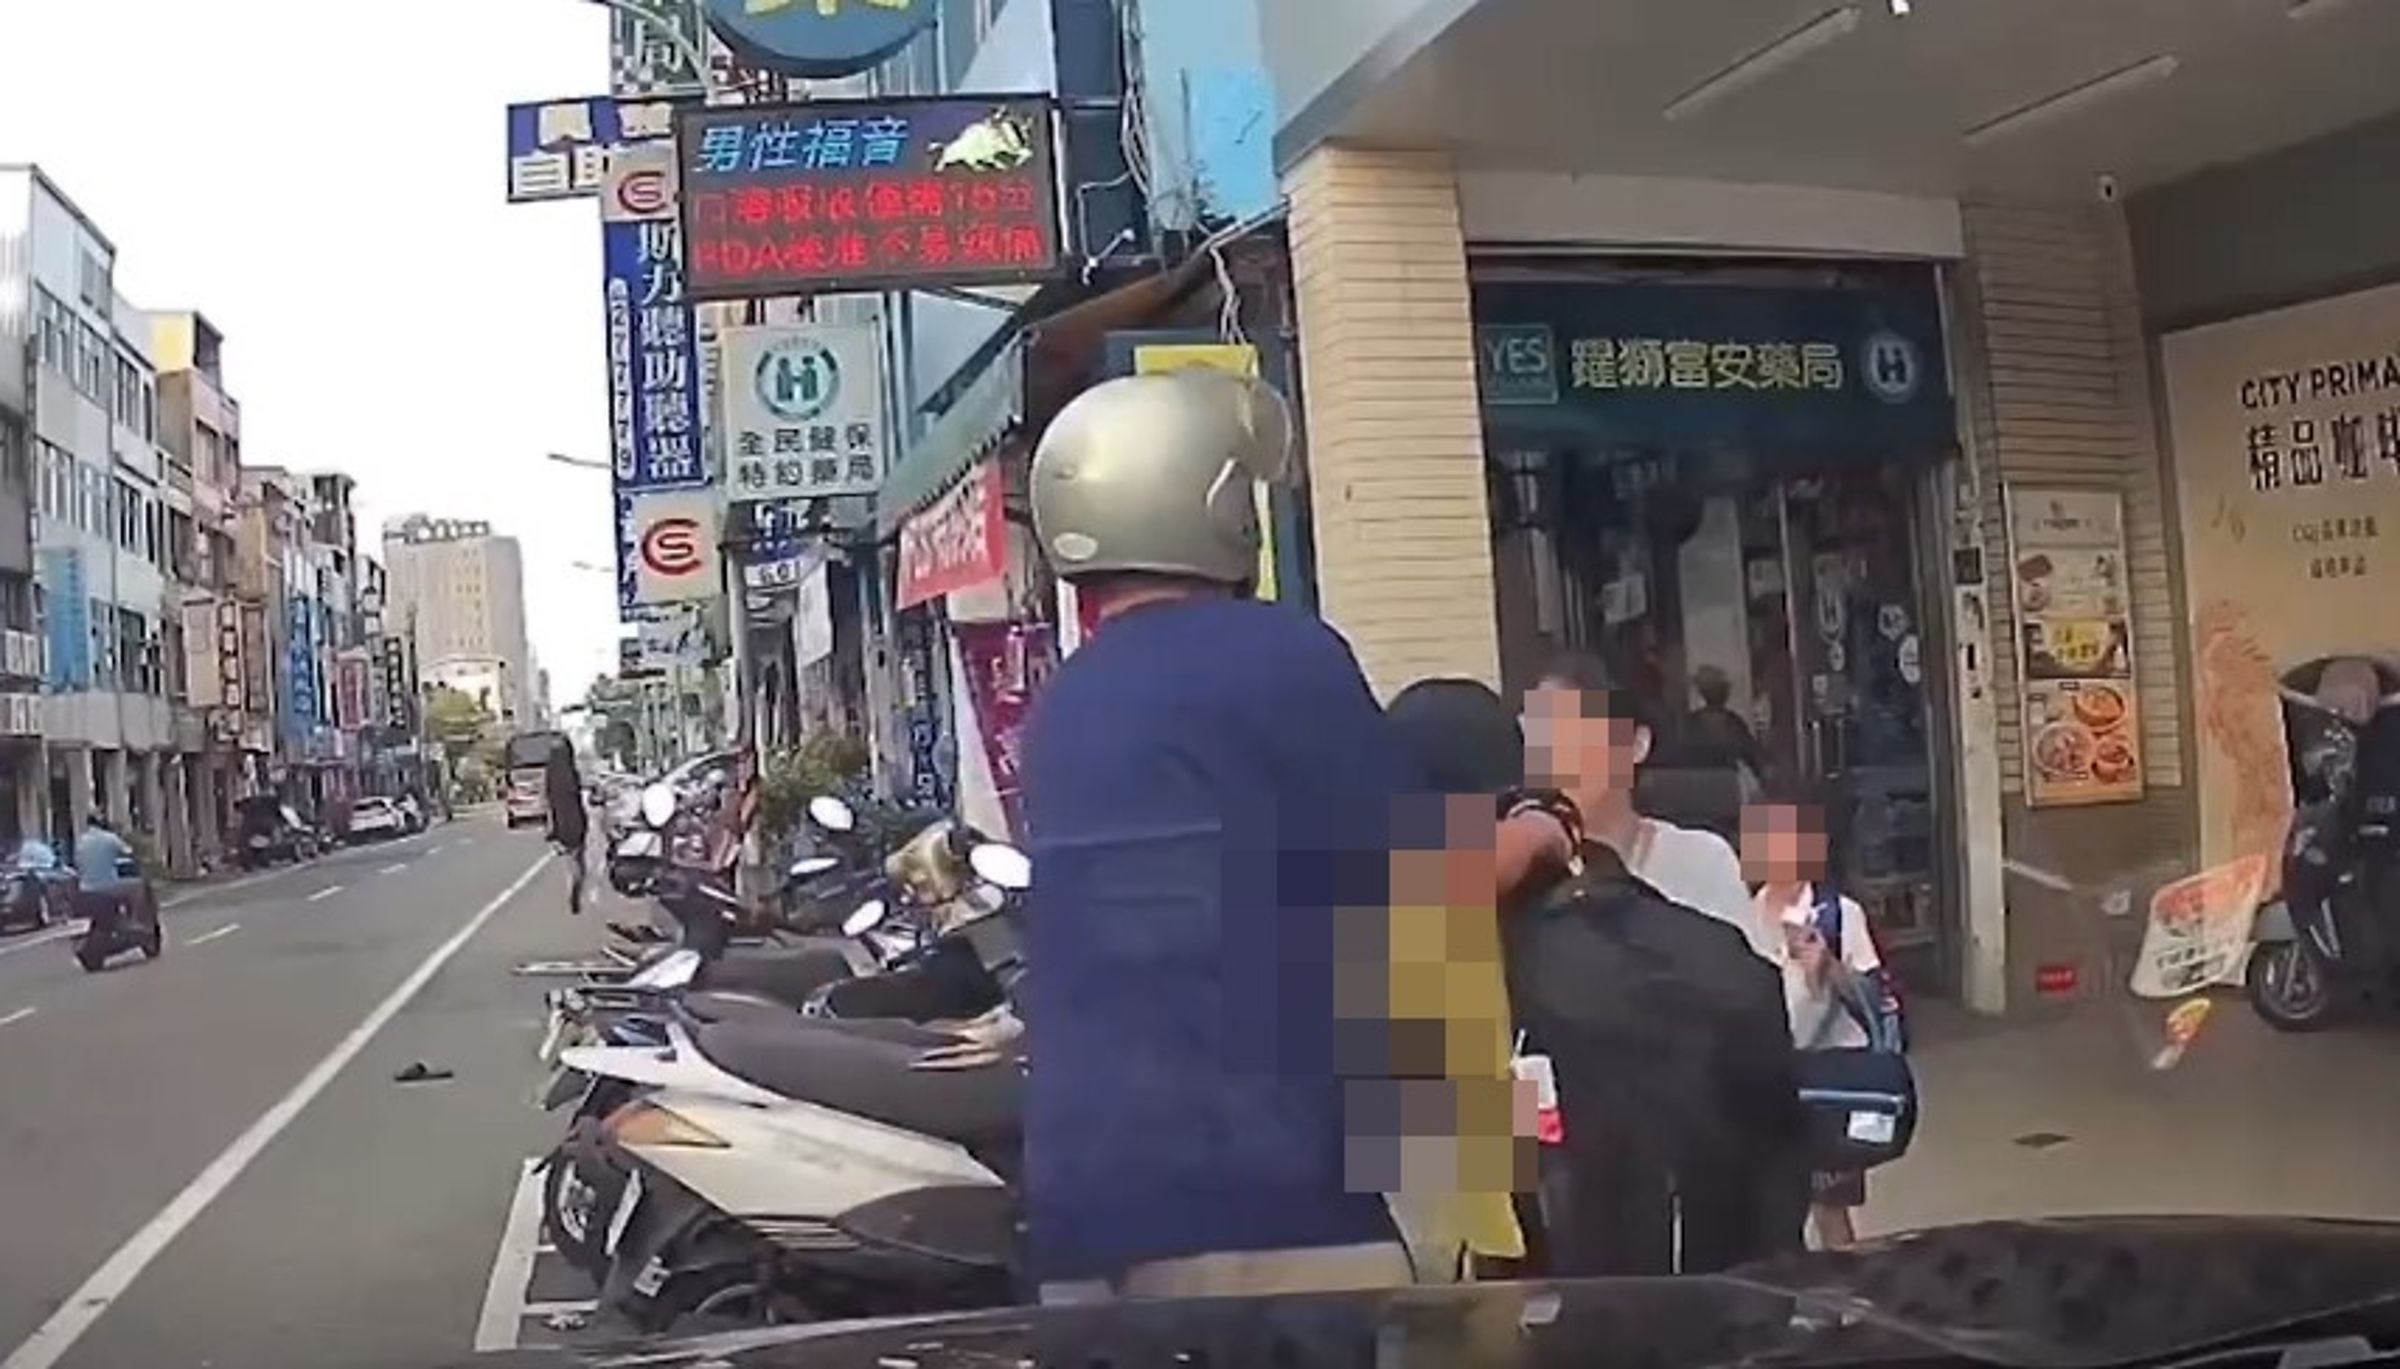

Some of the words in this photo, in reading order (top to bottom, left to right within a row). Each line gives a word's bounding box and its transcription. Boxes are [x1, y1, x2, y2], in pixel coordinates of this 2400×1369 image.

[694, 115, 909, 172] 男性福音
[1484, 337, 1547, 374] YES
[1570, 338, 1844, 390] 躍獅富安藥局
[2241, 373, 2301, 408] CITY
[2309, 356, 2400, 398] PRIMA
[739, 422, 876, 456] 全民健保
